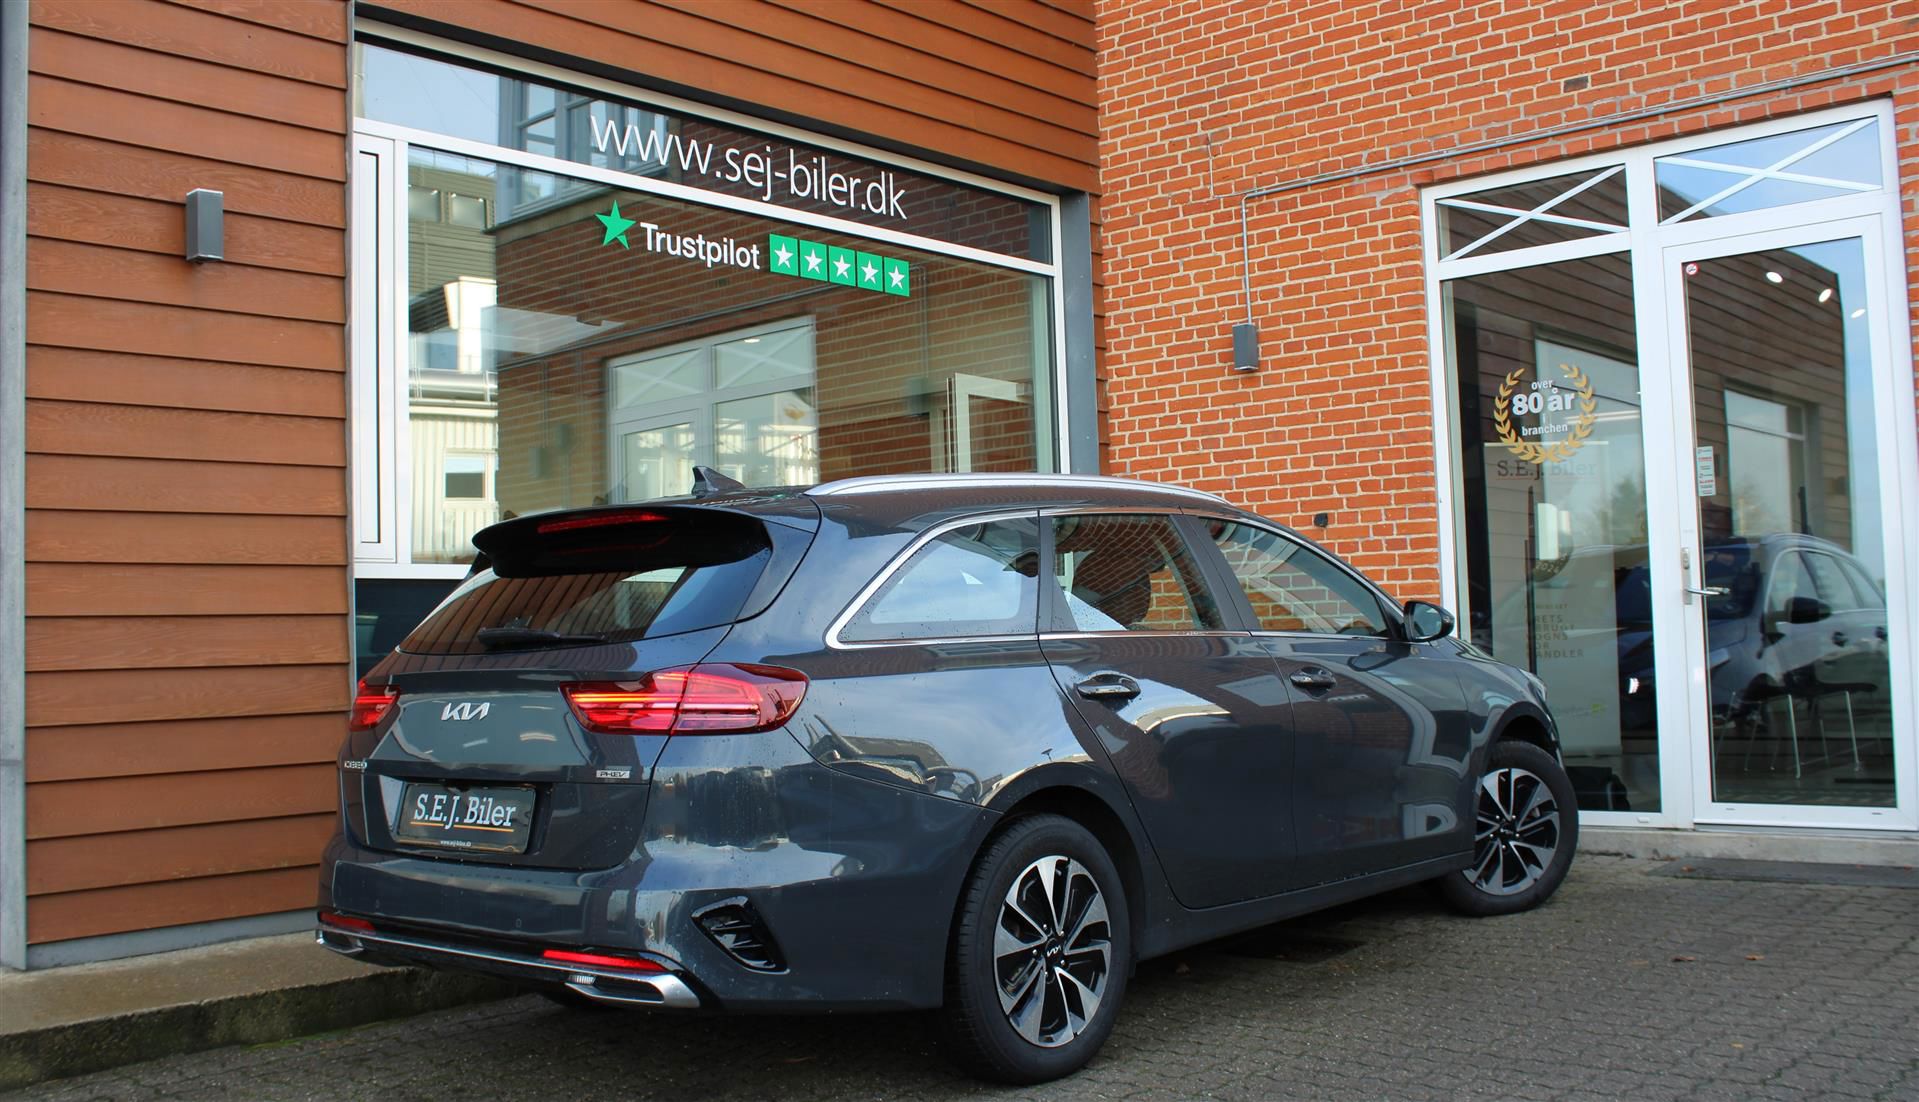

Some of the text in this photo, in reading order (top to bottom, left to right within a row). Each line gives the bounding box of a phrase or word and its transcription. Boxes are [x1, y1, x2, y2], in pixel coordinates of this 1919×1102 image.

[591, 115, 908, 219] www.sej-biler.dk
[640, 222, 761, 270] Trustpilot
[1531, 380, 1553, 390] over
[1512, 387, 1575, 416] 80 år
[1521, 423, 1568, 436] branchen
[441, 702, 490, 721] KIA
[600, 770, 626, 778] PHEV
[414, 793, 517, 830] S.E.J. Biler
